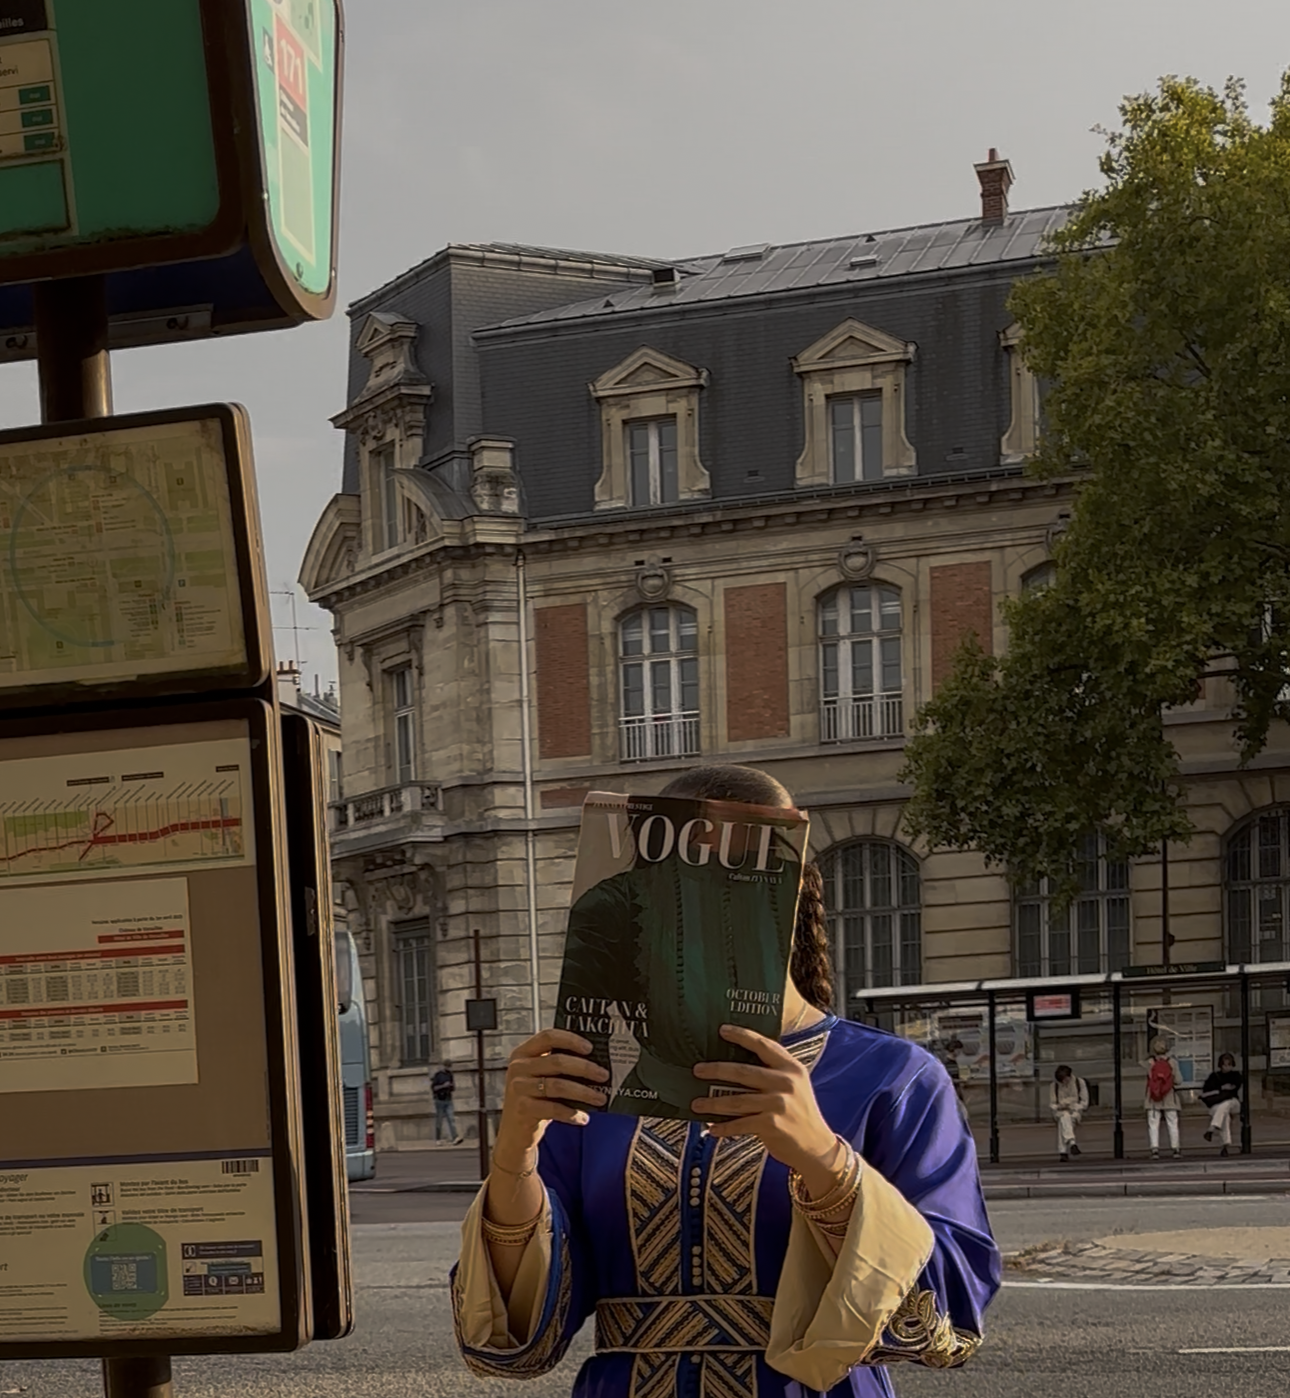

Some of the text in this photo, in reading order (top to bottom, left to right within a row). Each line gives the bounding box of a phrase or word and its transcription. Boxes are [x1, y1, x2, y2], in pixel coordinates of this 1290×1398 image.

[280, 39, 303, 95] 171
[605, 812, 786, 874] VOGUE
[1146, 964, 1198, 975] Hôtel de Ville
[725, 988, 781, 1004] OCTOBER
[635, 1002, 648, 1019] &
[730, 1000, 778, 1016] EDITION
